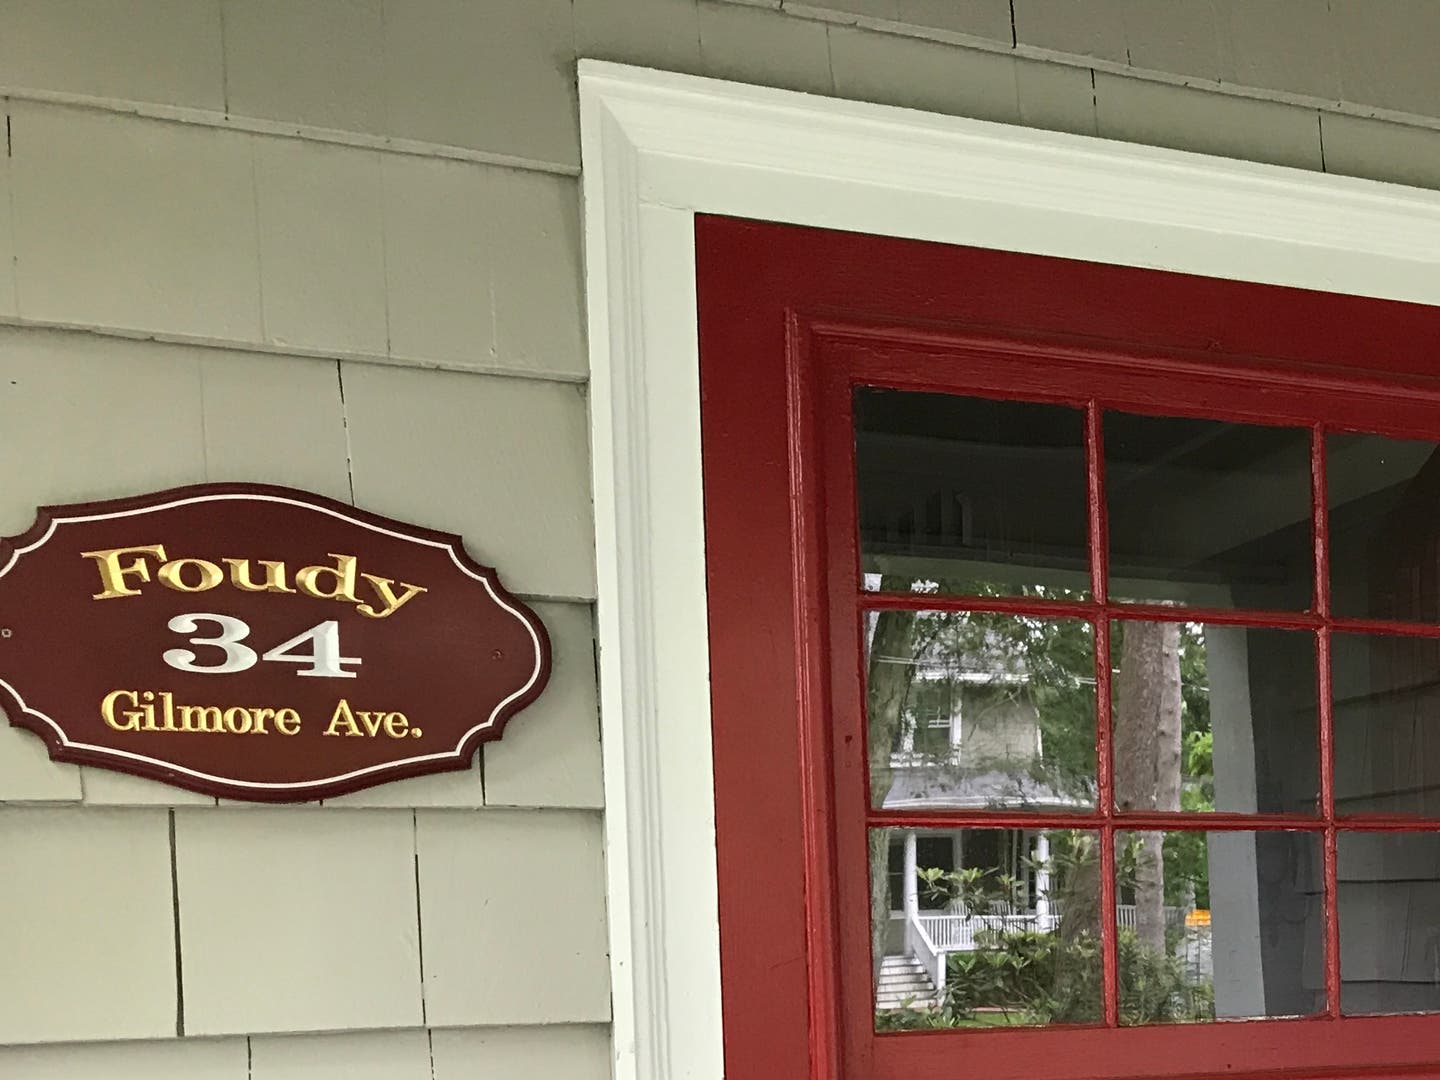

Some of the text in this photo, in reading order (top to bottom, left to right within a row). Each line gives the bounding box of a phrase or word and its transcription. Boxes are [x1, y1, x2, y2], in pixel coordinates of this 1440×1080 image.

[80, 543, 428, 619] Foudy
[162, 612, 363, 679] 34
[101, 689, 424, 739] Gilmore Ave.
